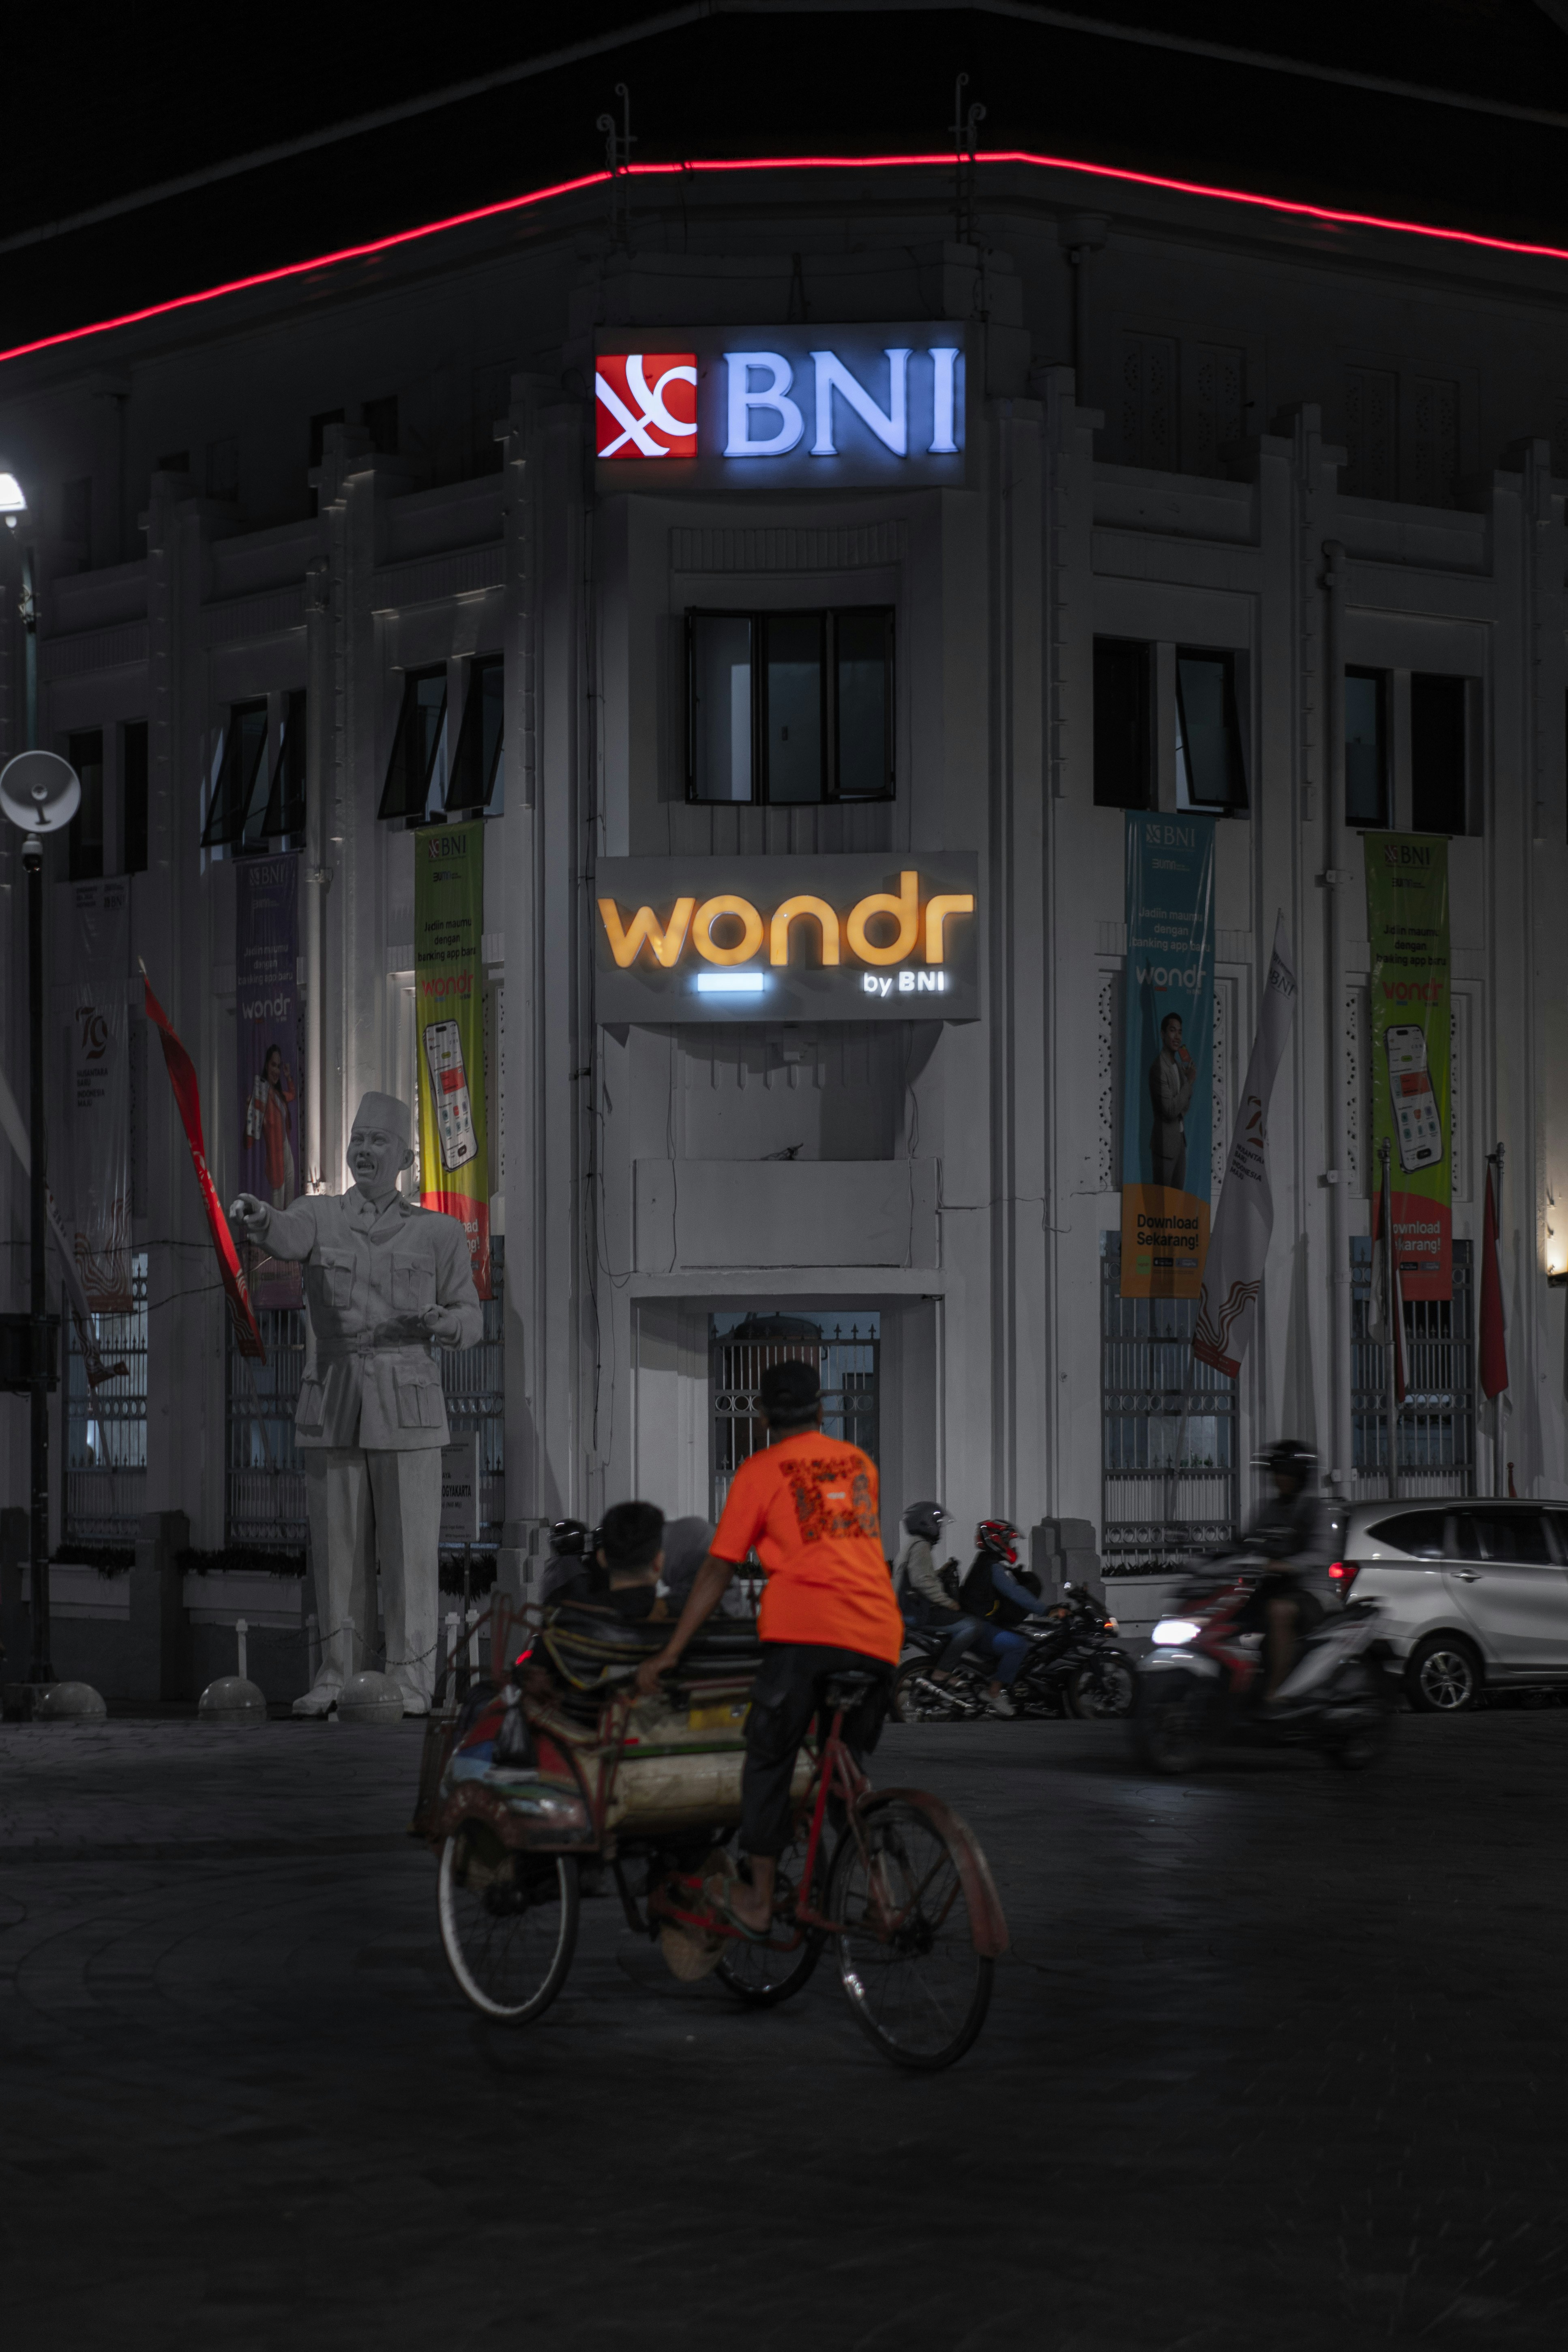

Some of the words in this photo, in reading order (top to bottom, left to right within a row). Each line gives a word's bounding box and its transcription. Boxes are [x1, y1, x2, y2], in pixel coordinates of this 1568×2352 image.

[722, 348, 960, 458] BNI
[1164, 826, 1195, 847] BNI
[442, 835, 466, 856] BNI
[1401, 846, 1430, 865] BNI
[262, 864, 283, 885] BNI
[597, 870, 974, 968] wondr
[1139, 907, 1167, 918] Jadiin
[425, 920, 443, 931] Jadiin
[446, 918, 471, 929] maumu
[1154, 923, 1188, 937] dengan
[435, 935, 460, 946] dengan
[1133, 936, 1168, 951] banking
[1170, 941, 1188, 953] app
[1190, 940, 1210, 952] bau
[1395, 940, 1426, 952] dengan
[418, 950, 445, 962] banking
[447, 949, 459, 961] app
[1410, 957, 1426, 967] app
[422, 970, 474, 997] wondr
[864, 972, 892, 997] by
[898, 971, 944, 991] BNI
[1136, 964, 1206, 987] wondr
[1270, 970, 1295, 996] BNI
[1382, 978, 1443, 1000] wondr
[242, 993, 290, 1019] wondr
[78, 1099, 92, 1107] MAJU
[1234, 1151, 1247, 1163] BARU
[1230, 1167, 1244, 1180] MAJU
[1232, 1159, 1262, 1182] INDONESIA
[1137, 1214, 1198, 1229] Download
[1393, 1221, 1441, 1234] ownload
[1137, 1232, 1199, 1250] Sekarang!
[1395, 1237, 1441, 1254] karang!
[442, 1485, 471, 1497] OGYAKARTA
